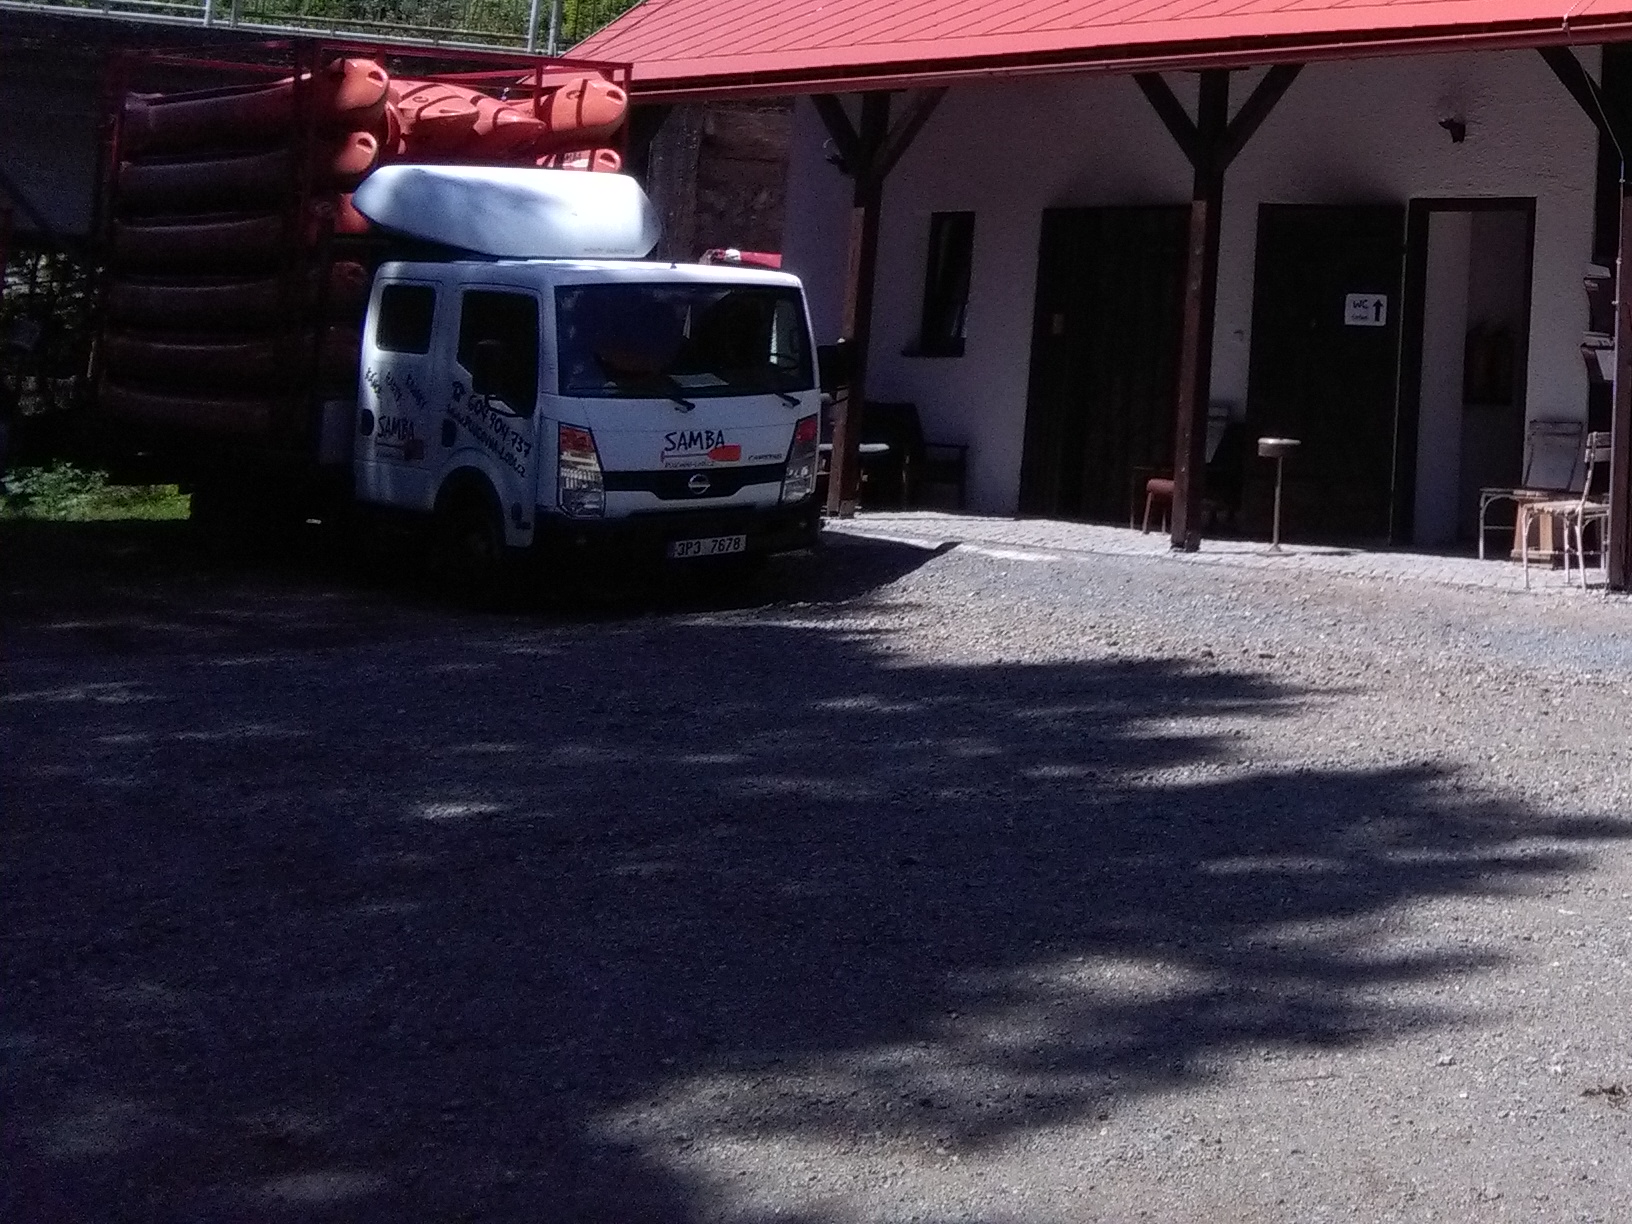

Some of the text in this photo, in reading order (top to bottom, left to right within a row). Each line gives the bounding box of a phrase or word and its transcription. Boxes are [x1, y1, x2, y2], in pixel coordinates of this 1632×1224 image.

[1353, 299, 1368, 309] WC
[377, 416, 415, 440] SAMBA
[489, 413, 510, 441] 904
[511, 431, 532, 457] 737
[664, 430, 726, 451] SAMBA
[677, 538, 741, 556] 3P3 7678
